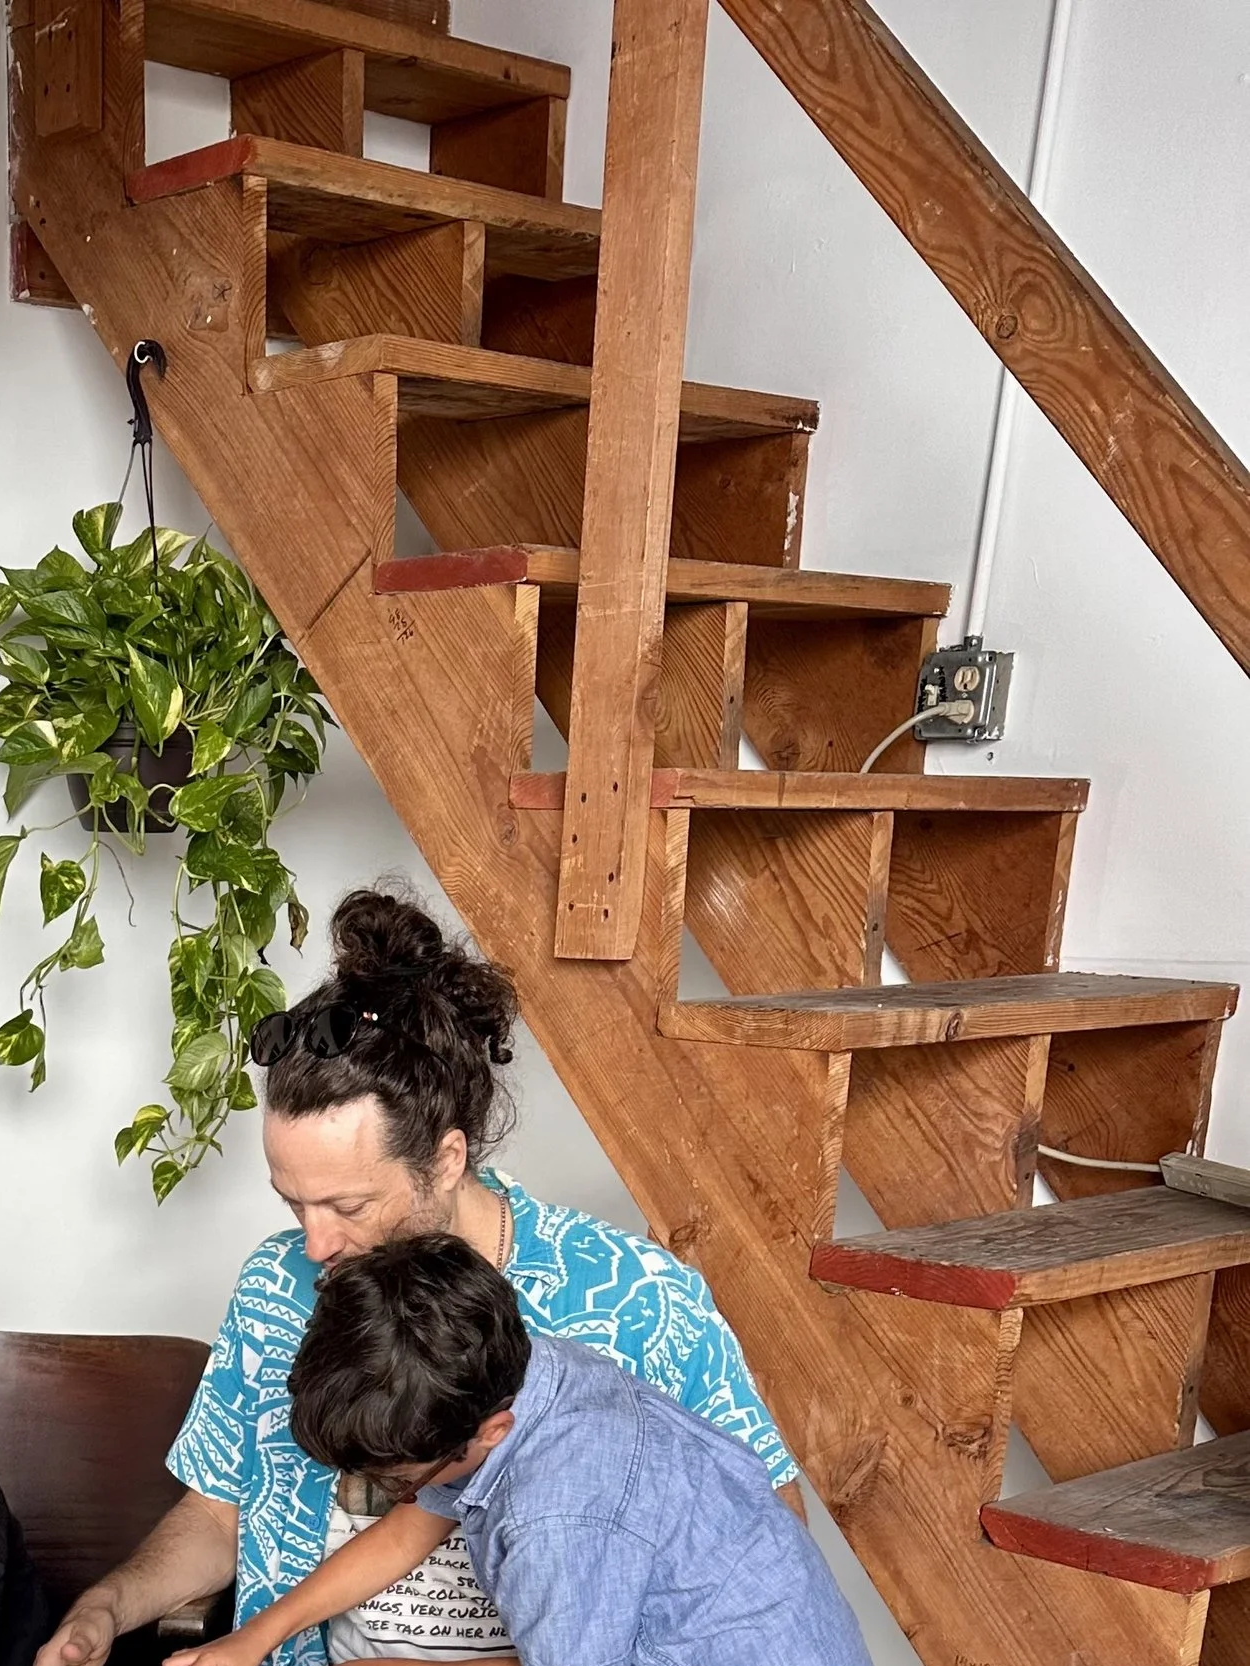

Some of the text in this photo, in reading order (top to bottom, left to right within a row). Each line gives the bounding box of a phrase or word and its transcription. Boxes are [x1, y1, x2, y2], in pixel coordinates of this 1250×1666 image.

[429, 1556, 470, 1570] BLACK
[410, 1603, 443, 1616] VERY
[448, 1607, 499, 1619] CURIO
[366, 1620, 390, 1630] SEE
[394, 1623, 425, 1636] TAG
[430, 1626, 451, 1637] ON
[456, 1627, 484, 1638] HER
